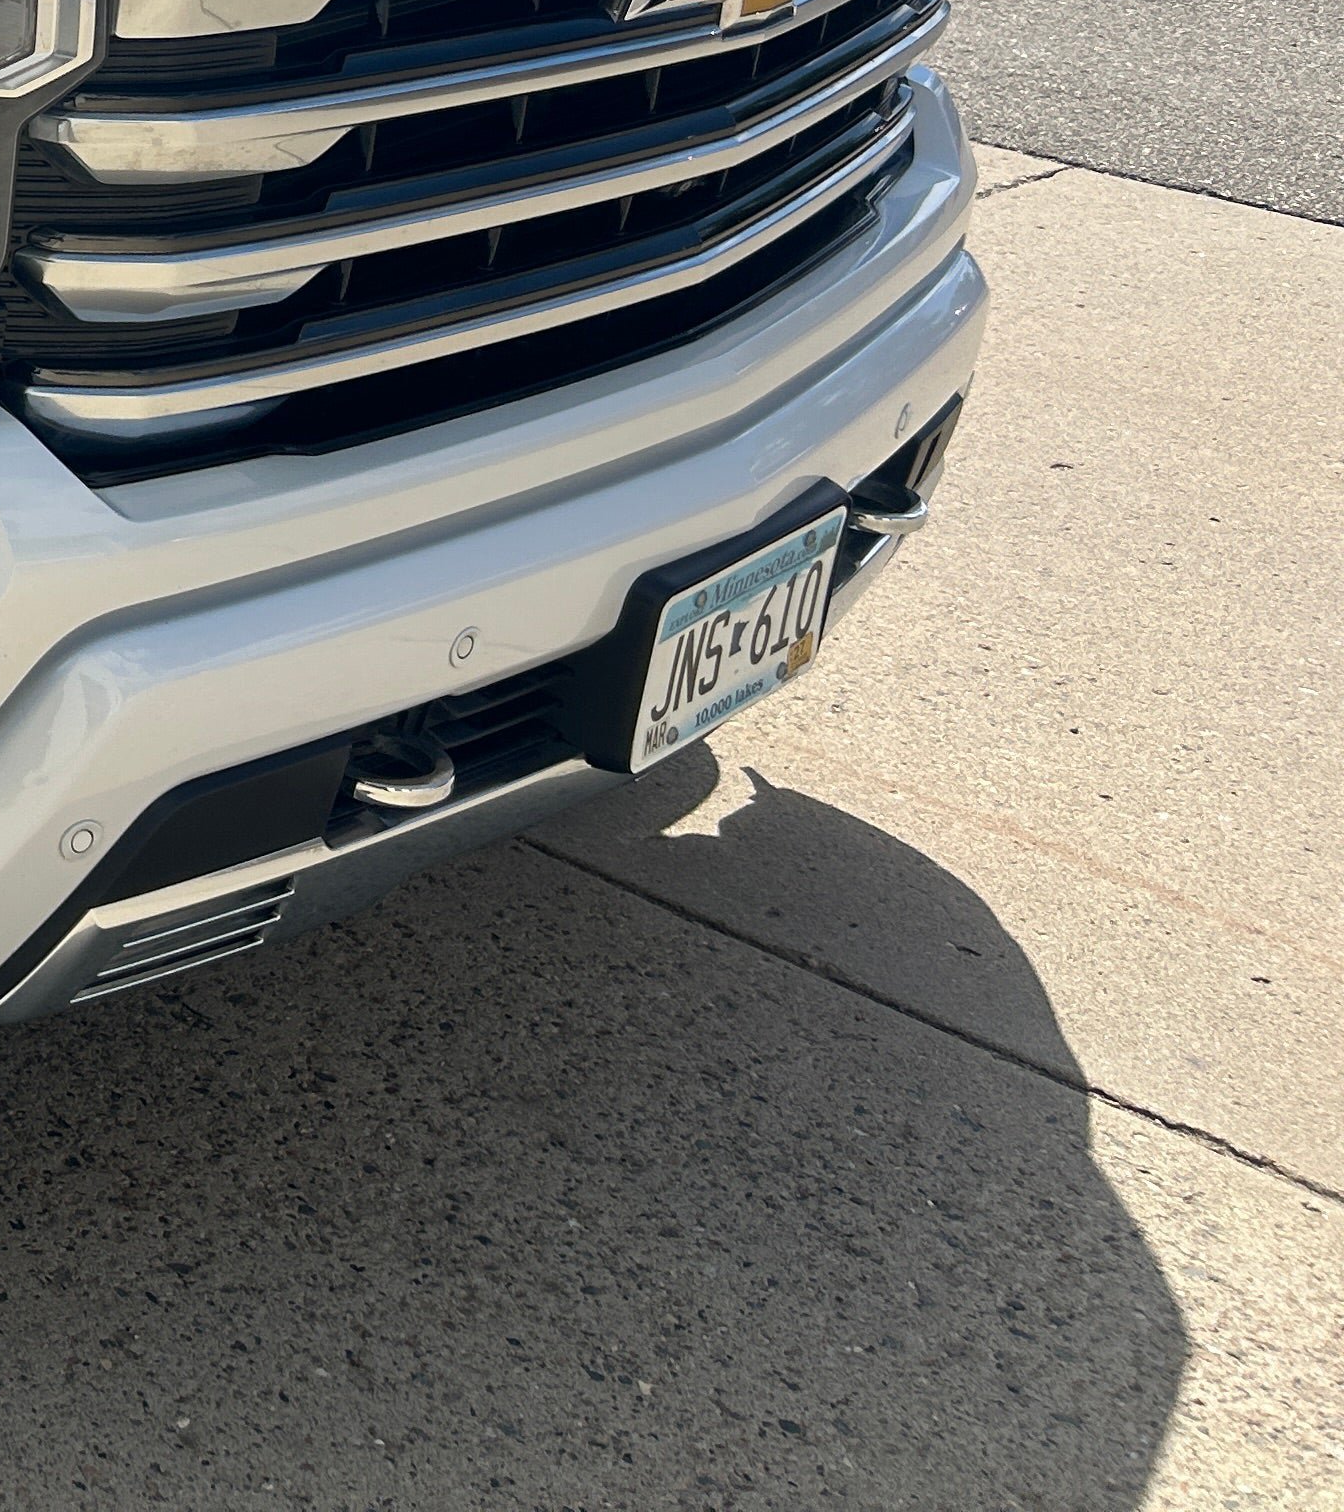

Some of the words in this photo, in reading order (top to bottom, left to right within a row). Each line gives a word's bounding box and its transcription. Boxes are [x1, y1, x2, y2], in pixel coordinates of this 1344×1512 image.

[651, 610, 731, 722] JNS
[750, 559, 823, 666] 610
[694, 695, 732, 728] 10,000
[735, 679, 765, 706] lakes
[644, 721, 667, 756] MAR
